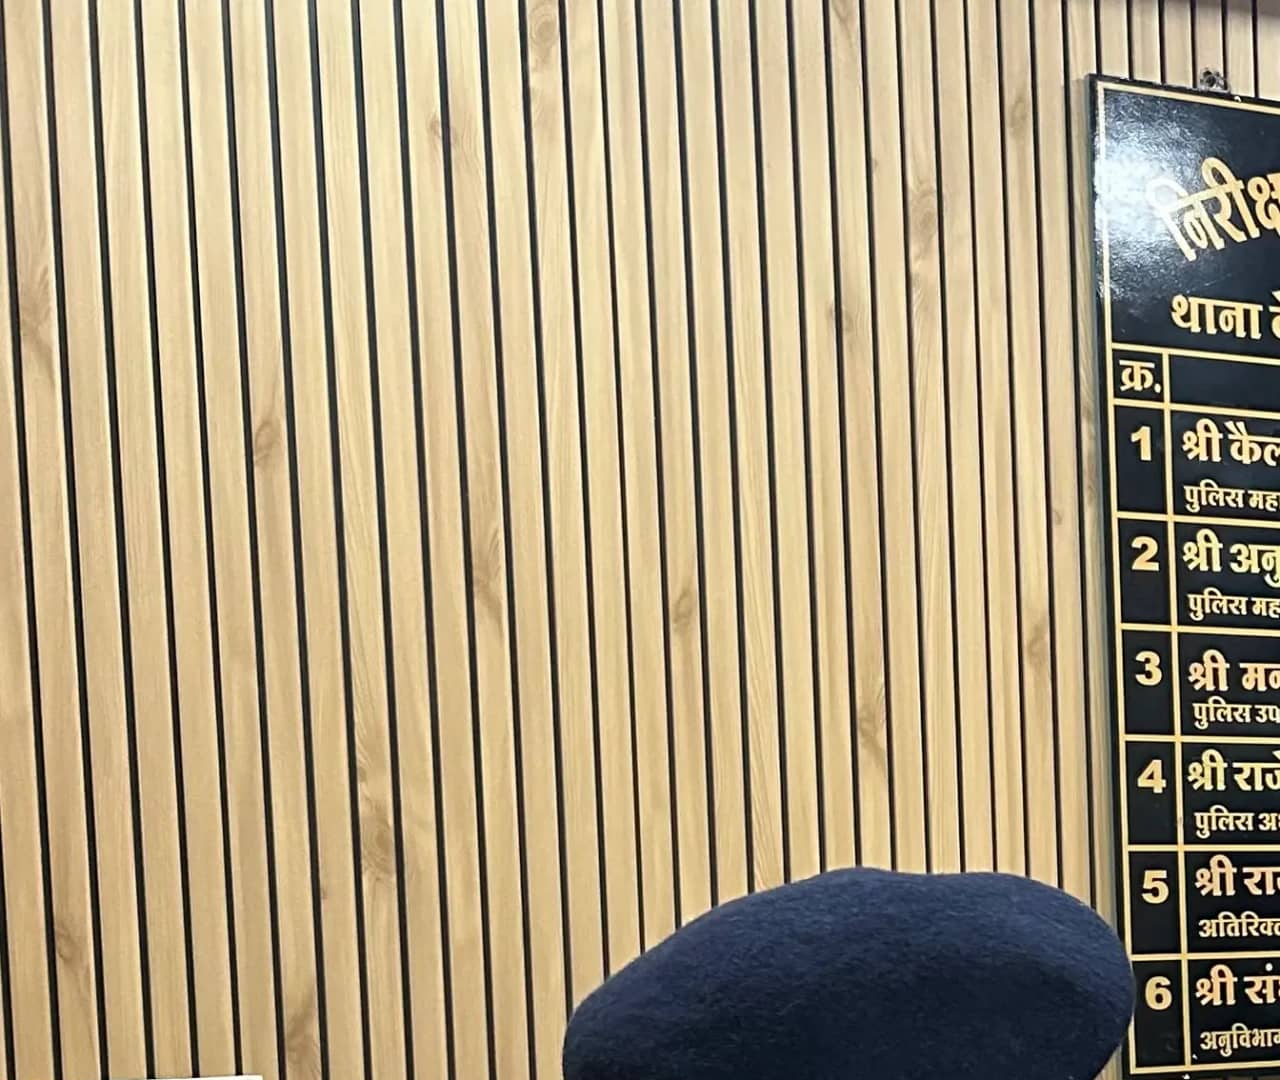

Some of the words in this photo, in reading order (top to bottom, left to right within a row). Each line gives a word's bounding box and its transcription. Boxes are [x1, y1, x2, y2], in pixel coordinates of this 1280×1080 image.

[1171, 293, 1263, 338] थाना
[1119, 360, 1162, 393] क्र.
[1130, 425, 1153, 462] 1
[1182, 418, 1223, 463] श्री
[1184, 478, 1245, 512] पुलिस
[1131, 536, 1160, 571] 2
[1182, 528, 1223, 573] श्री
[1187, 586, 1249, 621] पुलिस
[1135, 650, 1163, 686] 3
[1187, 648, 1230, 692] श्री
[1192, 696, 1251, 729] पुलिस
[1255, 704, 1280, 724] उप
[1137, 759, 1167, 794] 4
[1187, 748, 1228, 792] श्री
[1194, 804, 1255, 838] पुलिस
[1141, 869, 1169, 904] 5
[1195, 854, 1237, 897] श्री
[1144, 975, 1173, 1011] 6
[1195, 964, 1237, 1006] श्री
